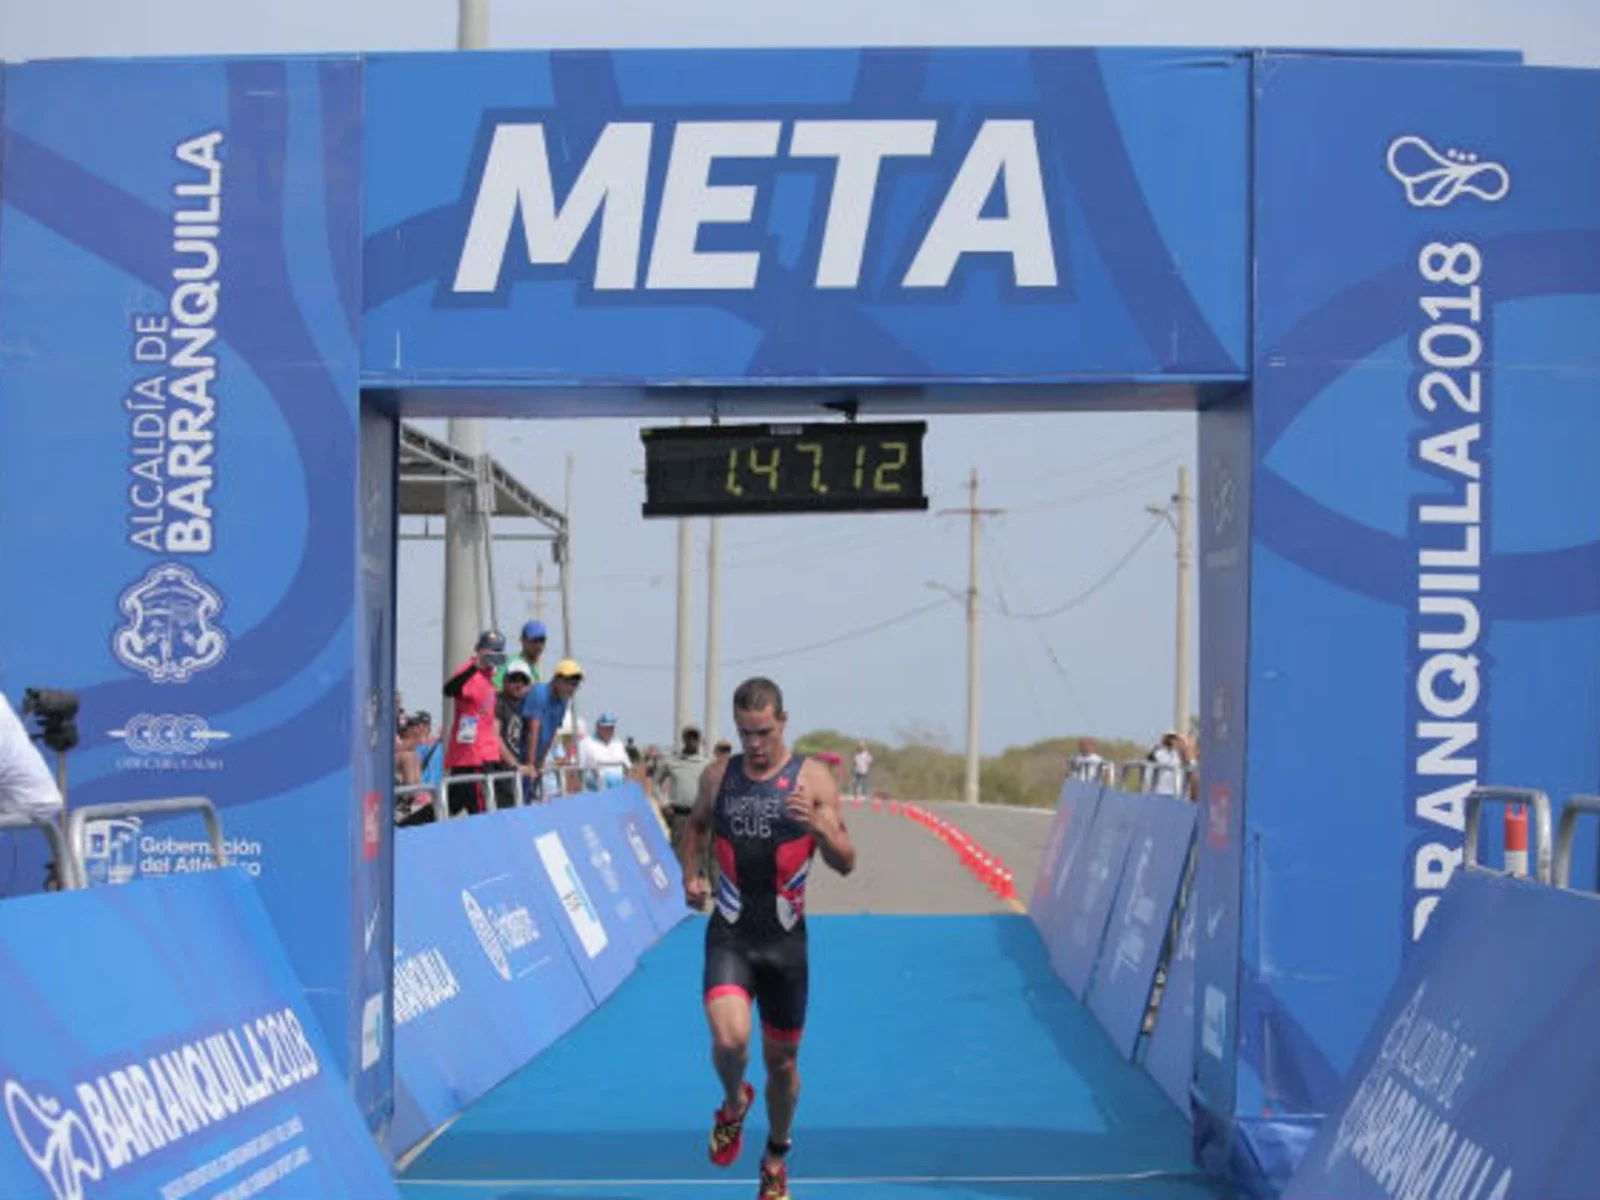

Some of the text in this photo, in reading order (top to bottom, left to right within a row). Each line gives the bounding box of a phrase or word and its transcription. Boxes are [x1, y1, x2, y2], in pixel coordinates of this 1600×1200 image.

[452, 119, 1058, 293] META
[166, 131, 223, 554] BARRANQUILLA
[126, 314, 169, 552] ALCALDÍA DE
[140, 836, 262, 856] Gobernción
[140, 857, 170, 874] del
[730, 817, 772, 838] CUB
